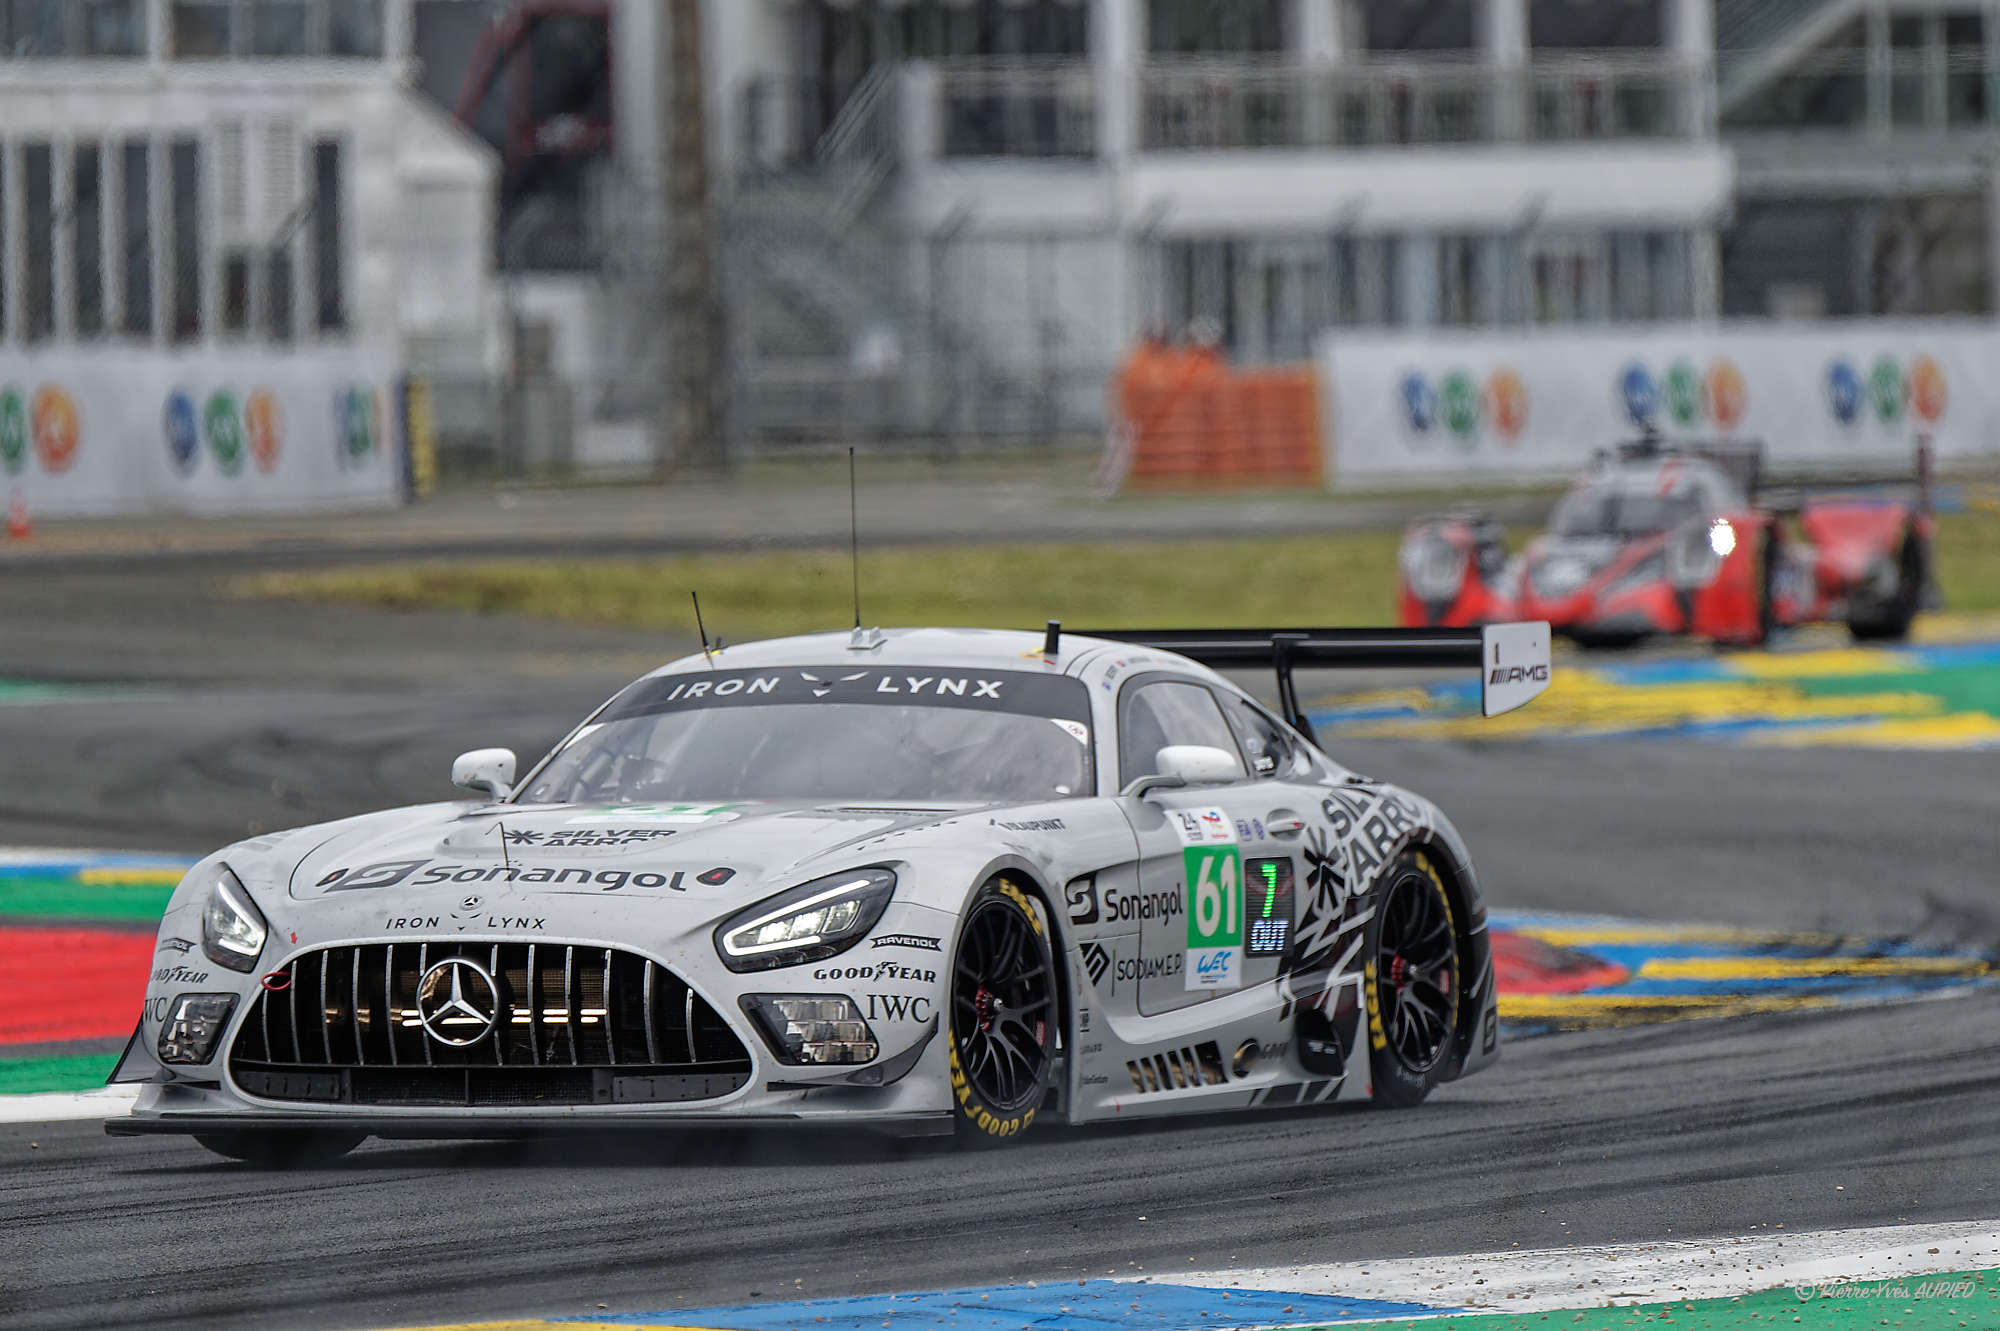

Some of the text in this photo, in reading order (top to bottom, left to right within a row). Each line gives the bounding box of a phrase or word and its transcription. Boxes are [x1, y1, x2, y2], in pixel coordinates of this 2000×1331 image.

[1508, 665, 1548, 683] AMG
[667, 676, 1004, 701] IRON LYNX
[549, 829, 677, 838] SILVER
[411, 865, 687, 892] Sonangol
[1104, 883, 1183, 927] Sonangol
[1196, 854, 1236, 937] 61
[385, 916, 546, 930] IRON LYNX
[877, 936, 937, 948] RAVENOL
[813, 963, 937, 983] GOODYEAR
[1196, 951, 1233, 974] WEC
[866, 994, 931, 1023] IWC
